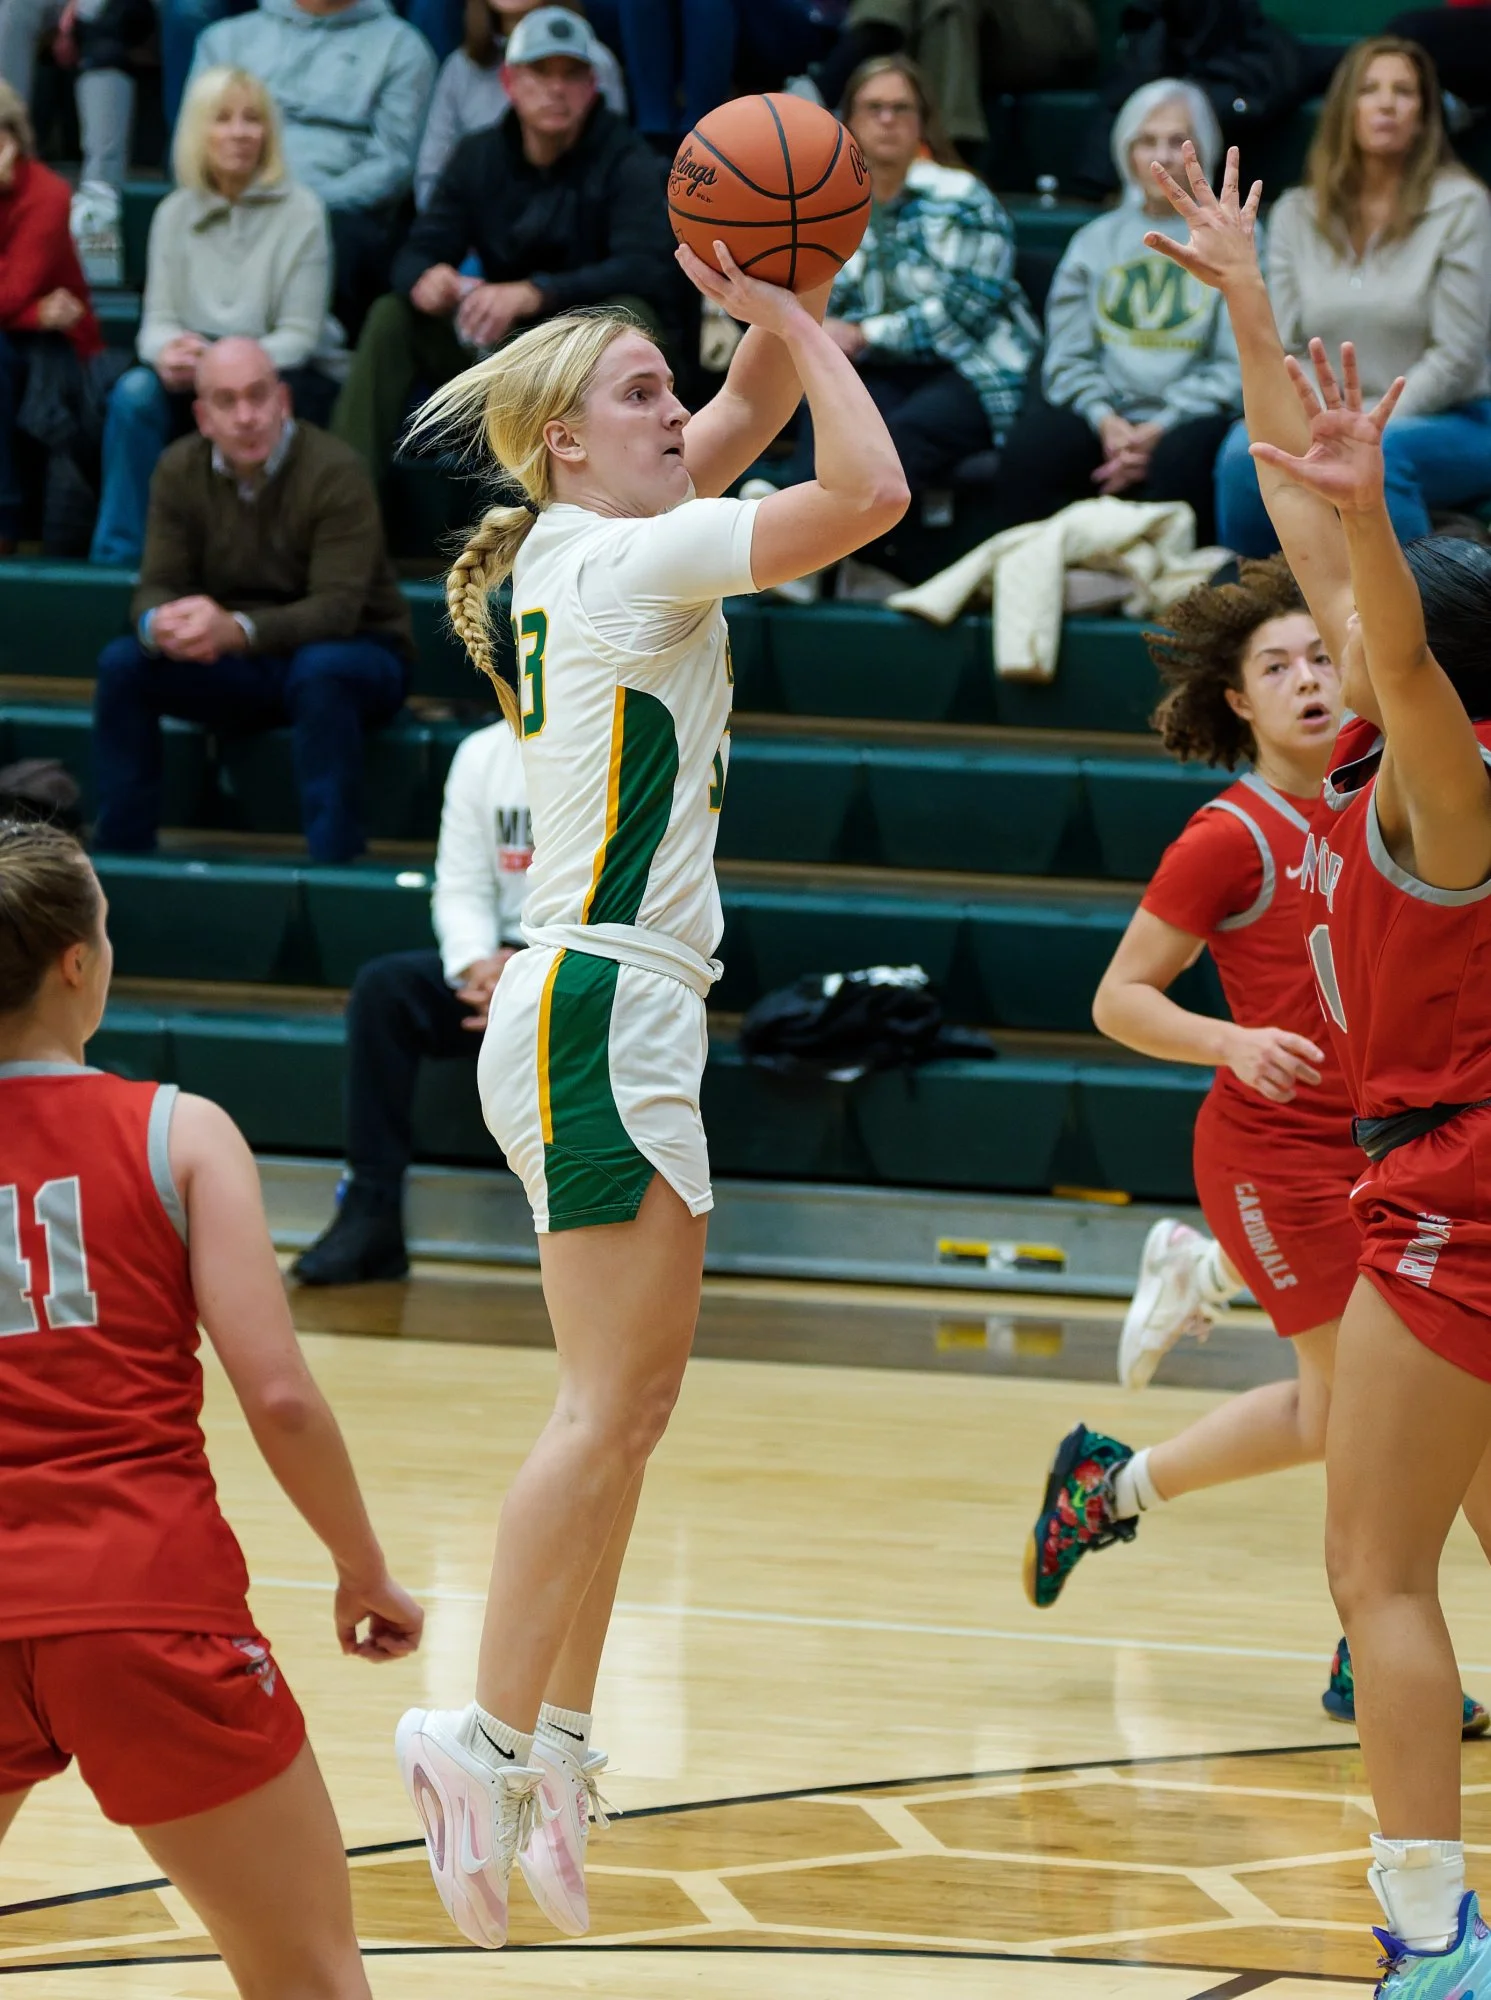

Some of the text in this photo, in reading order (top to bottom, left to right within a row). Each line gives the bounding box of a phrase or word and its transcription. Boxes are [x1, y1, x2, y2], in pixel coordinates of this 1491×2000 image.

[673, 145, 718, 197] lings
[511, 607, 549, 741] 3
[1234, 1182, 1299, 1290] CARDINALS
